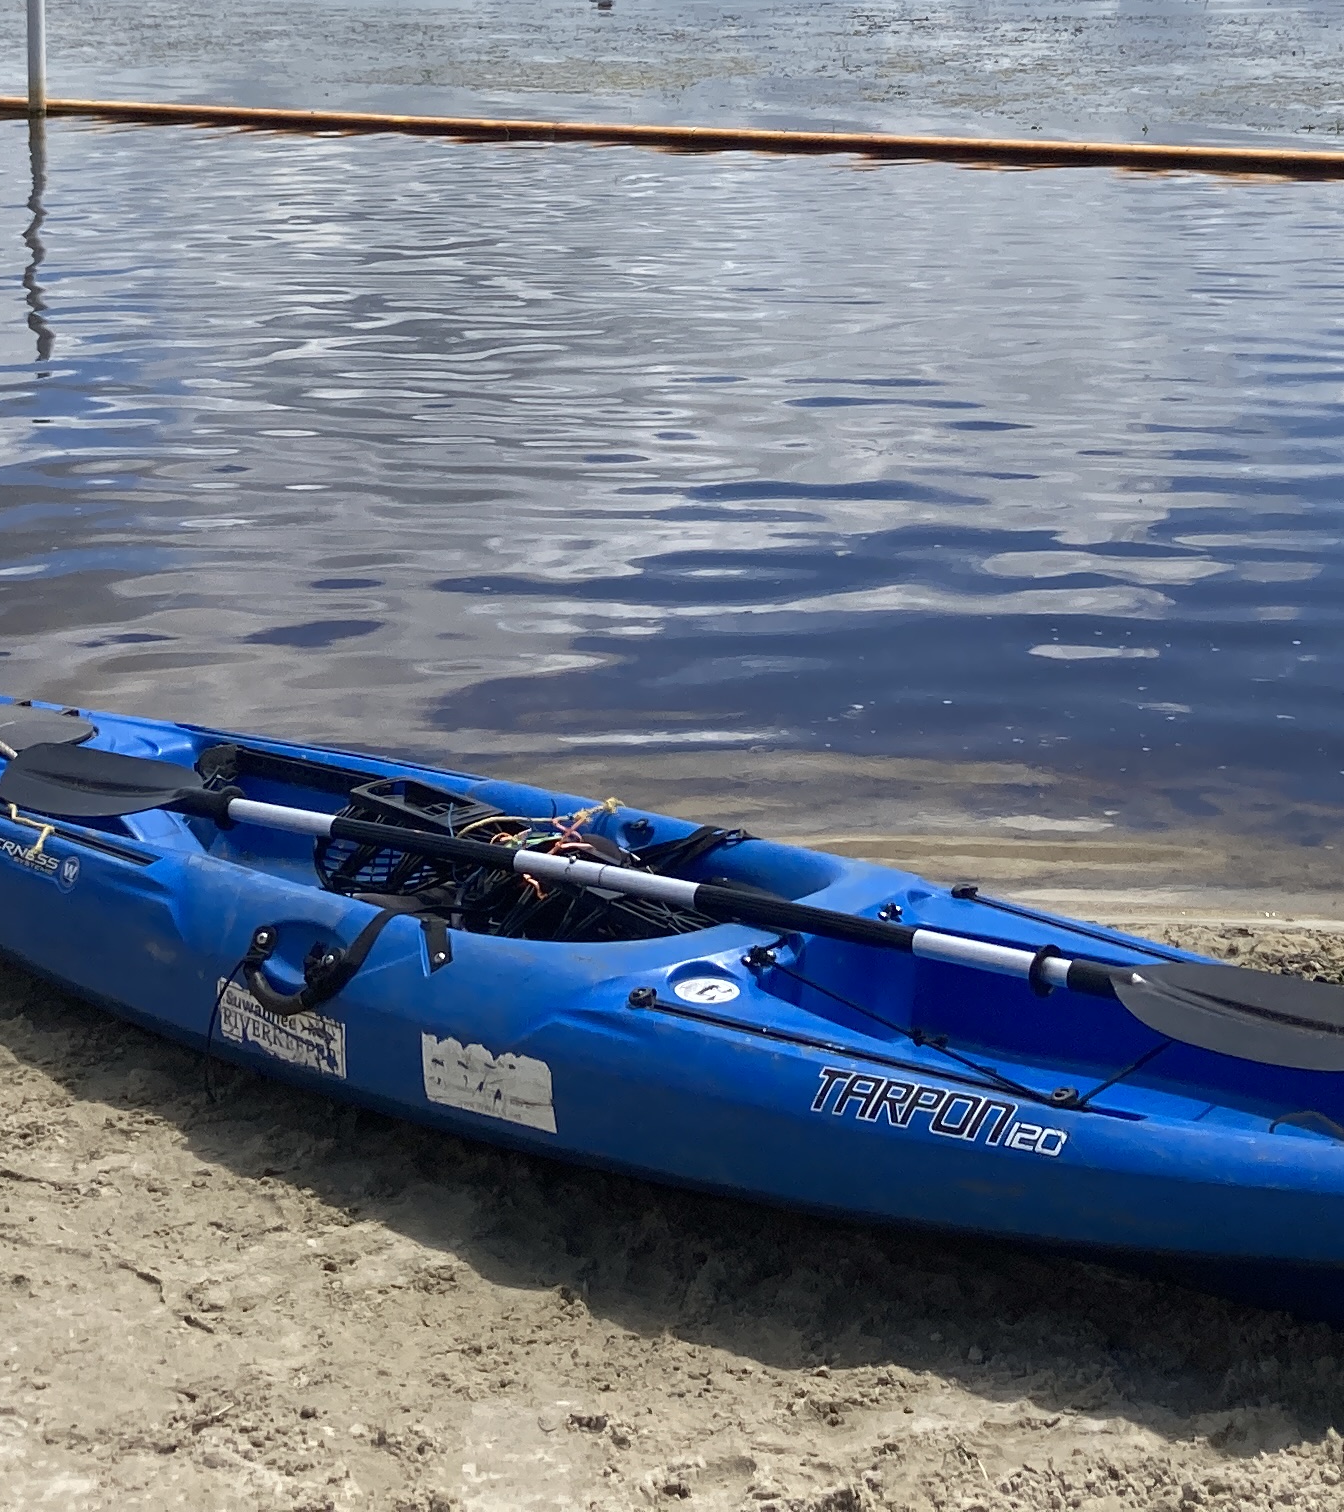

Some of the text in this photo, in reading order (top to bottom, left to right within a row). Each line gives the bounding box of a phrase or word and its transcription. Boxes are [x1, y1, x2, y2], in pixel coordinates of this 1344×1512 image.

[222, 1006, 339, 1072] RIVERKEEPR
[810, 1065, 1068, 1157] TARPON 120
